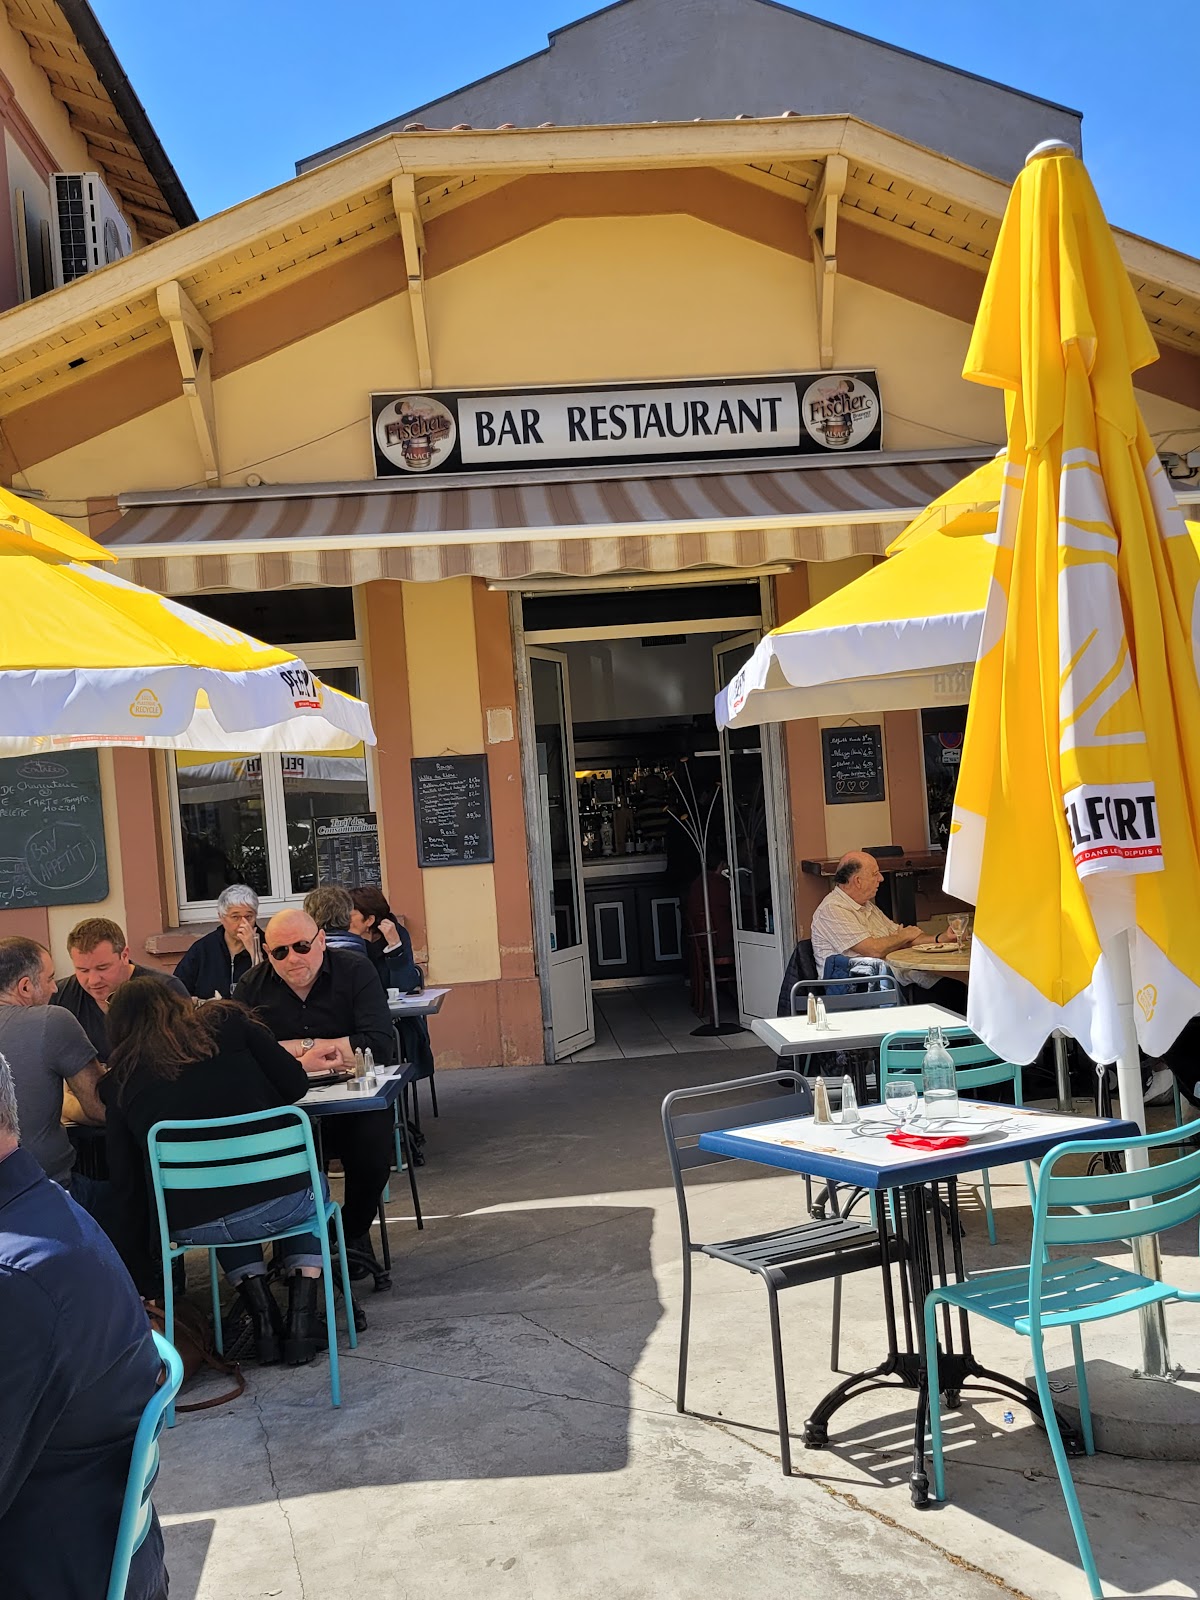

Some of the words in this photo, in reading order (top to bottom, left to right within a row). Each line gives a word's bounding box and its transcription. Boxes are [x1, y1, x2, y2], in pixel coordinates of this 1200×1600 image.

[809, 393, 866, 422] Fischer
[385, 414, 446, 445] Fischer
[475, 408, 544, 447] BAR
[567, 397, 782, 442] RESTAURANT
[826, 430, 849, 438] ALSACE
[405, 451, 431, 460] ALSACE
[351, 816, 366, 826] des
[41, 842, 86, 882] APPETIT
[1084, 849, 1109, 859] DANS
[1124, 848, 1153, 857] DEPUIS
